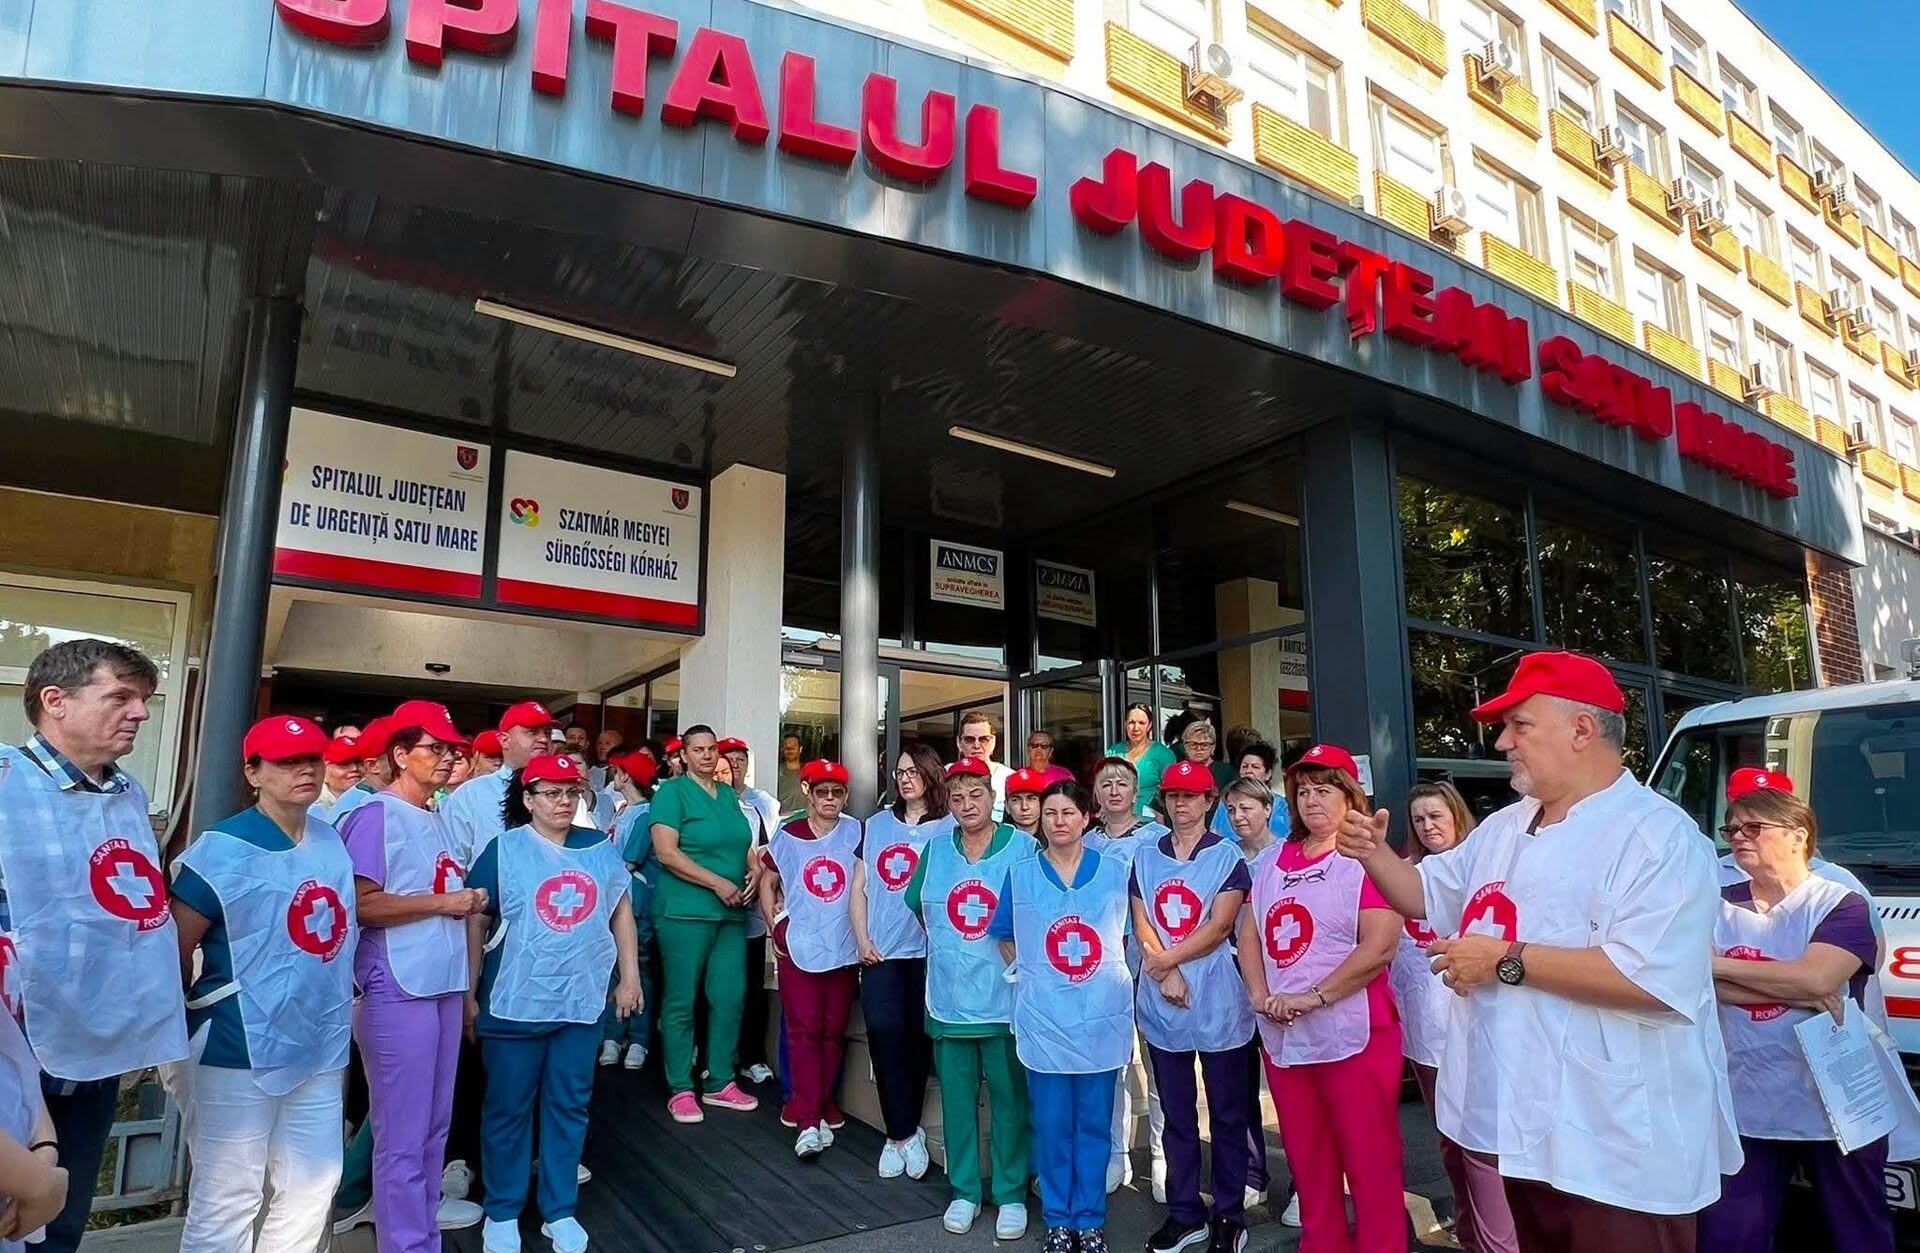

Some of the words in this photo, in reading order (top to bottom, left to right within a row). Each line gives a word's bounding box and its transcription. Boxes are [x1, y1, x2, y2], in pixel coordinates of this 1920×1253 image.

[311, 465, 383, 499] SPITALUL
[388, 479, 466, 514] JUDEȚEAN
[289, 502, 310, 526] DE
[316, 505, 389, 544] URGENȚĂ
[394, 518, 431, 544] SATU
[436, 525, 479, 551] MARE
[559, 508, 619, 538] SZATMÁR
[623, 519, 670, 547] MEGYEI
[545, 539, 625, 572] SÜRGŐSSÉGI
[630, 550, 678, 580] KÓRHÁZ
[942, 551, 994, 573] ANMCS
[935, 582, 1000, 599] SUPRAVEGHEREA
[1728, 946, 1757, 958] NITAS
